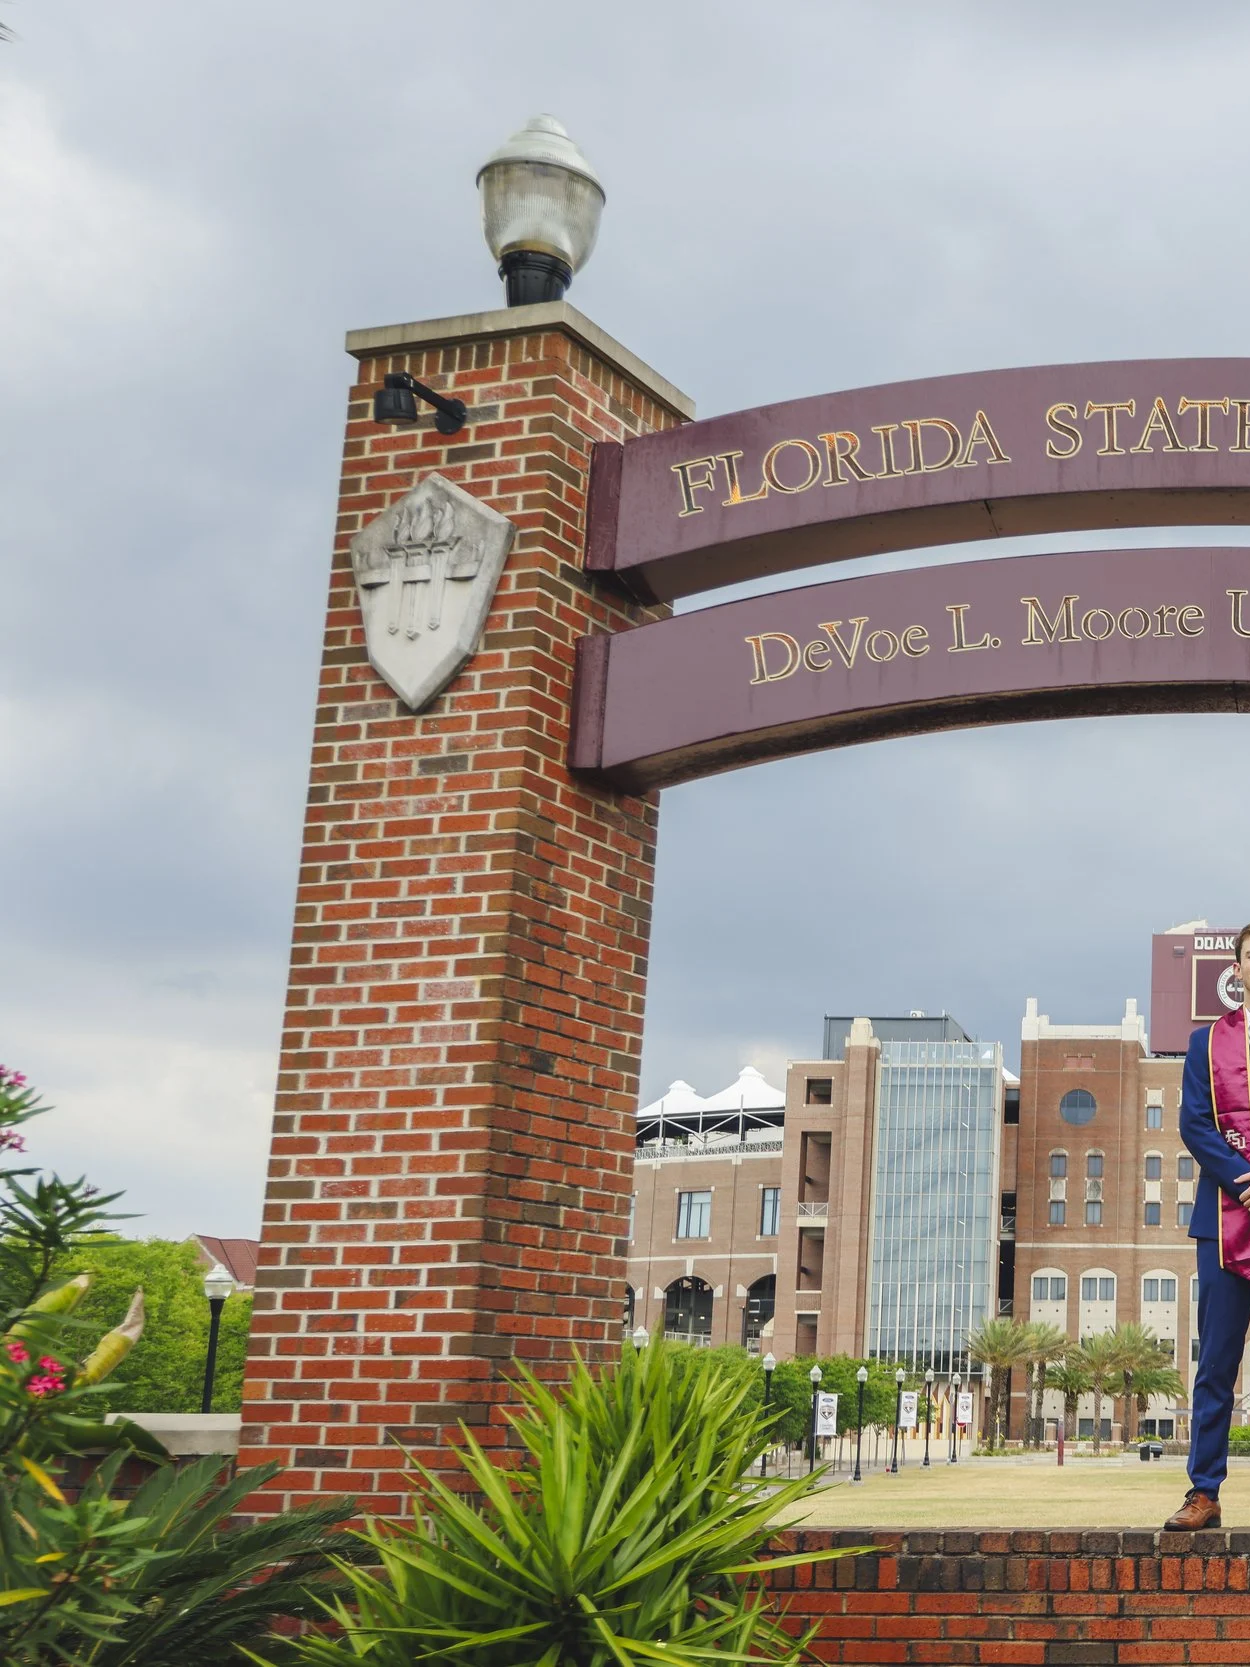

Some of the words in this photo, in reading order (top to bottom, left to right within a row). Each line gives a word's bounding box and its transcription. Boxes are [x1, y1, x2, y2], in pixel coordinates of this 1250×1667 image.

[670, 410, 1011, 517] FLORIDA
[745, 616, 929, 685] DeVoe
[946, 604, 1002, 653] L.
[1020, 594, 1205, 646] Moore
[1194, 936, 1236, 950] DOAK
[1225, 1129, 1246, 1149] FSU
